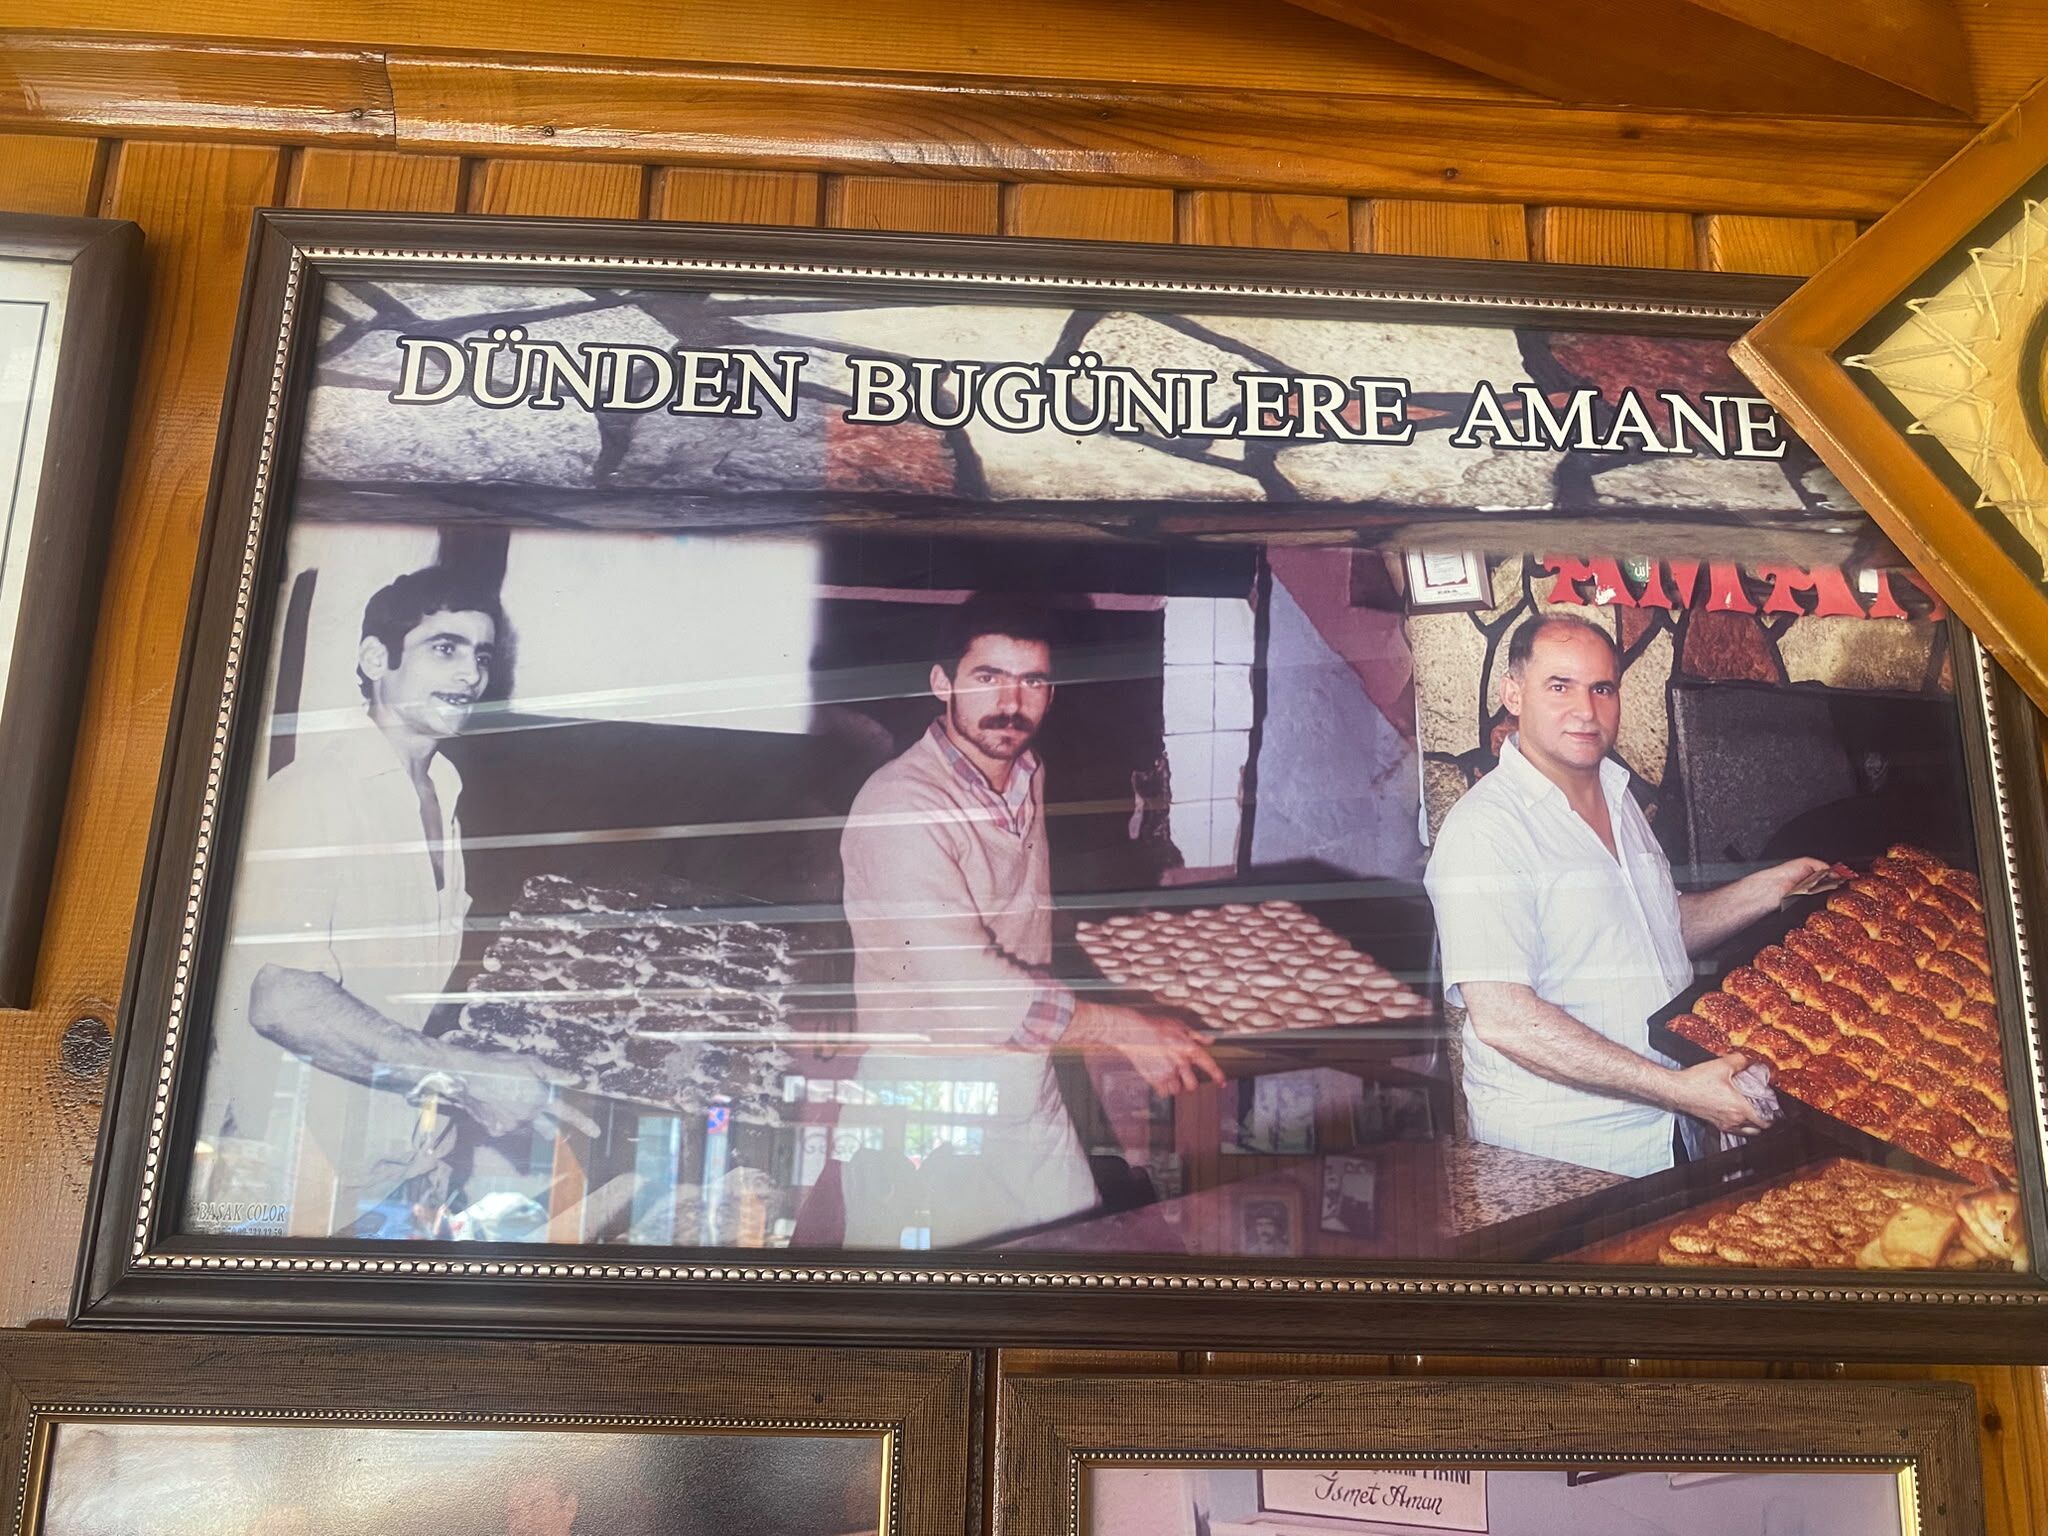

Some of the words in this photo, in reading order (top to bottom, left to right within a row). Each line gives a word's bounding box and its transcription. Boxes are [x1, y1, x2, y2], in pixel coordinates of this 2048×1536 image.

[392, 325, 807, 420] DÜNDEN
[843, 350, 1415, 445] BUGÜNLERE
[198, 1202, 243, 1225] BAŞAK
[246, 1204, 286, 1222] COLOR
[1382, 1485, 1443, 1515] Aman
